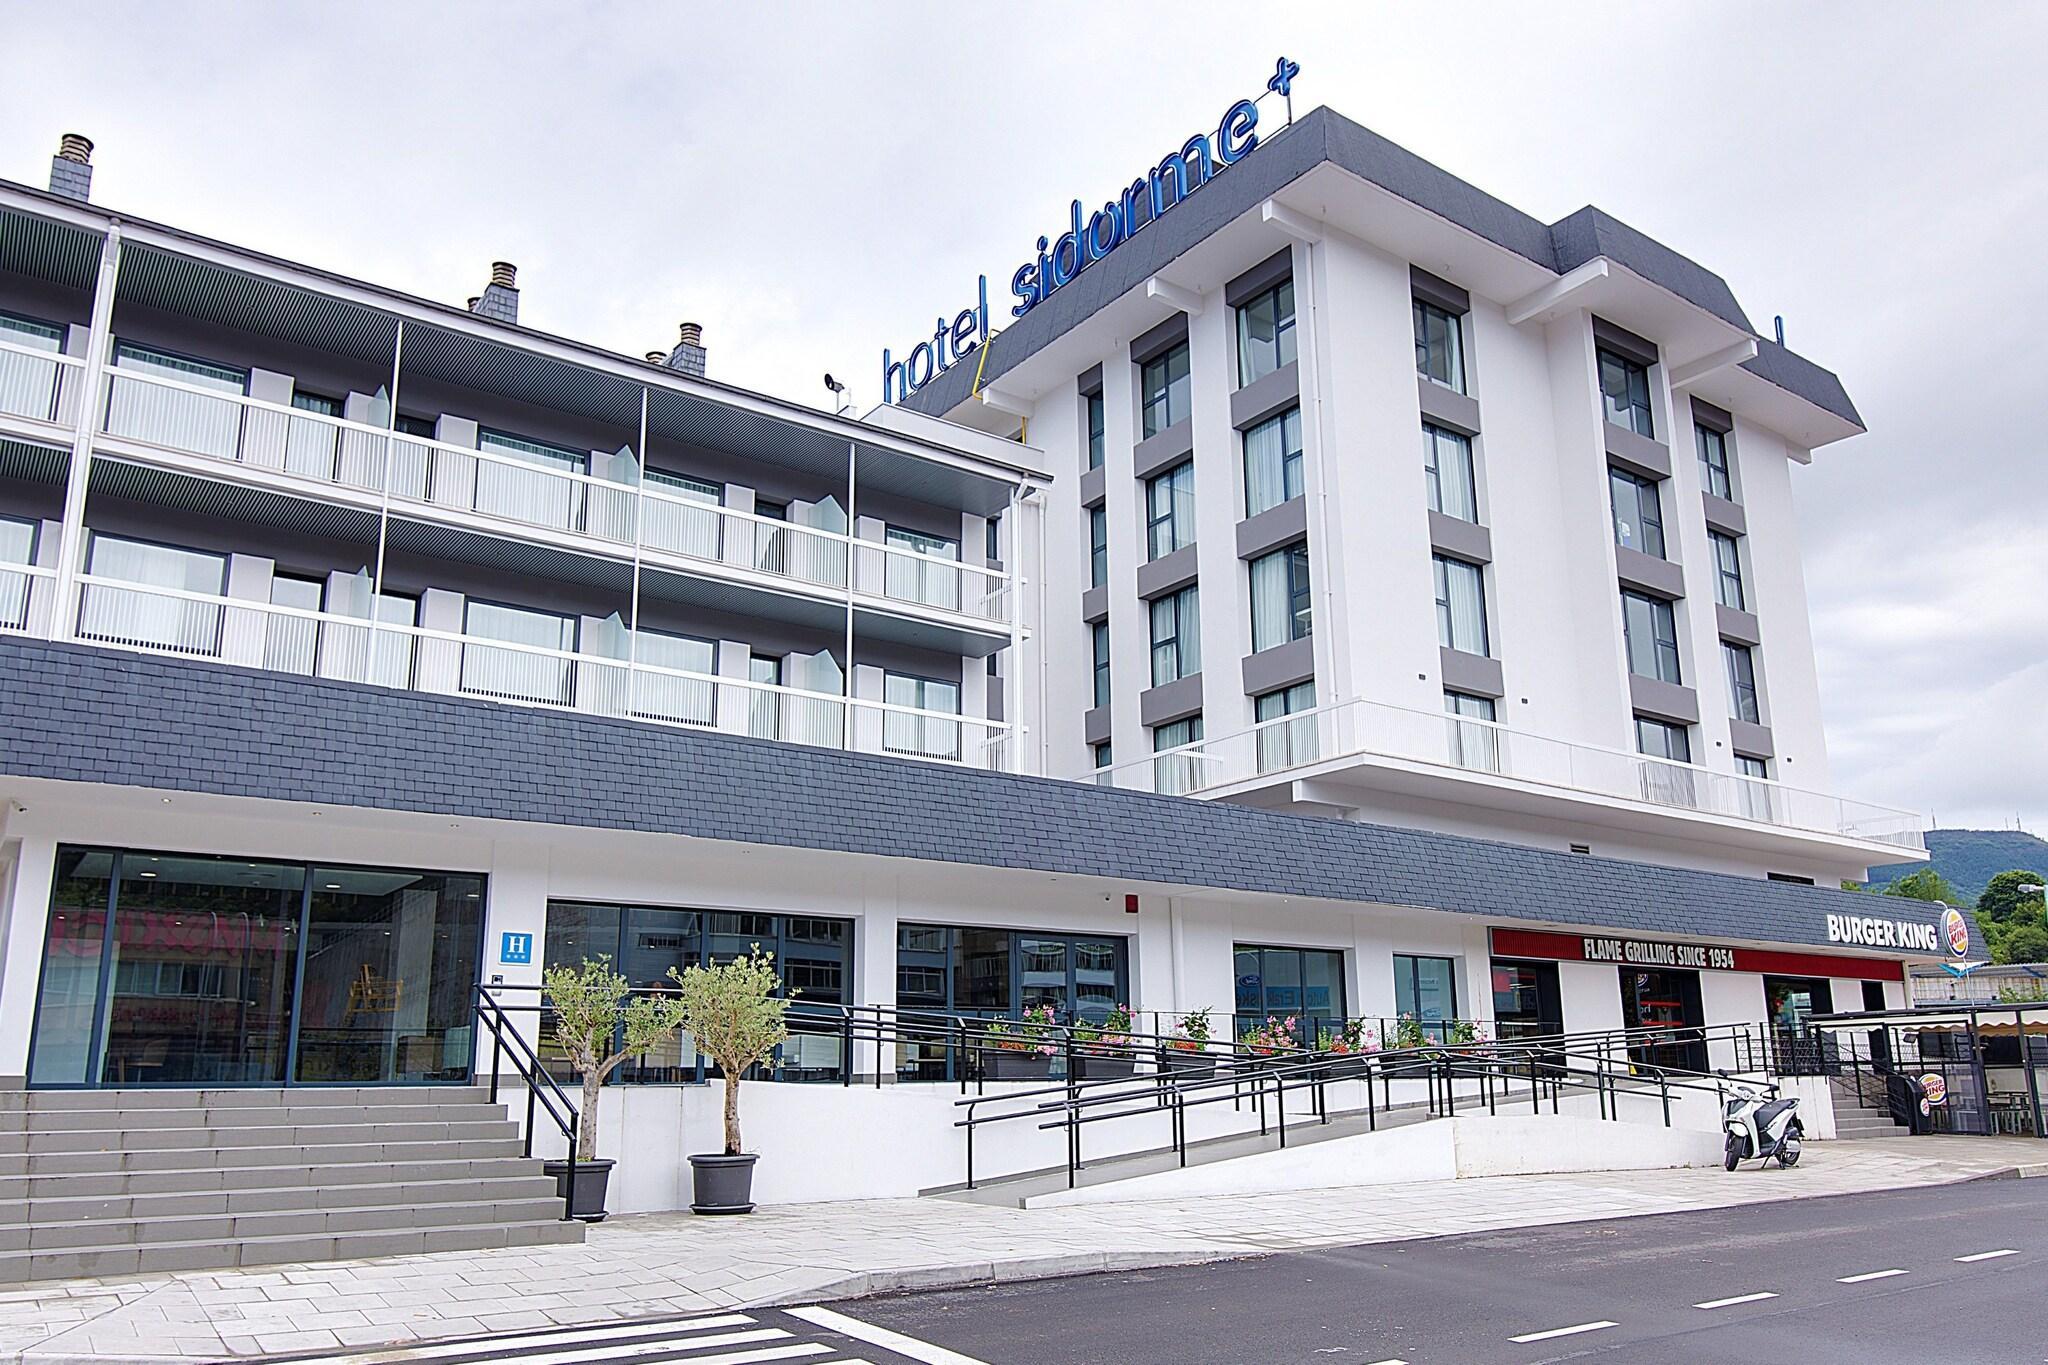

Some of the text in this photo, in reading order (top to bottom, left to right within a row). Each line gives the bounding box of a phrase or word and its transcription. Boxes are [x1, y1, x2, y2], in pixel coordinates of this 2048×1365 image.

[883, 99, 1259, 404] hotel sidorme
[508, 936, 526, 953] H
[1827, 914, 1938, 950] BURGER KING
[1583, 938, 1735, 968] FLAME GRILLING SINCE 1954
